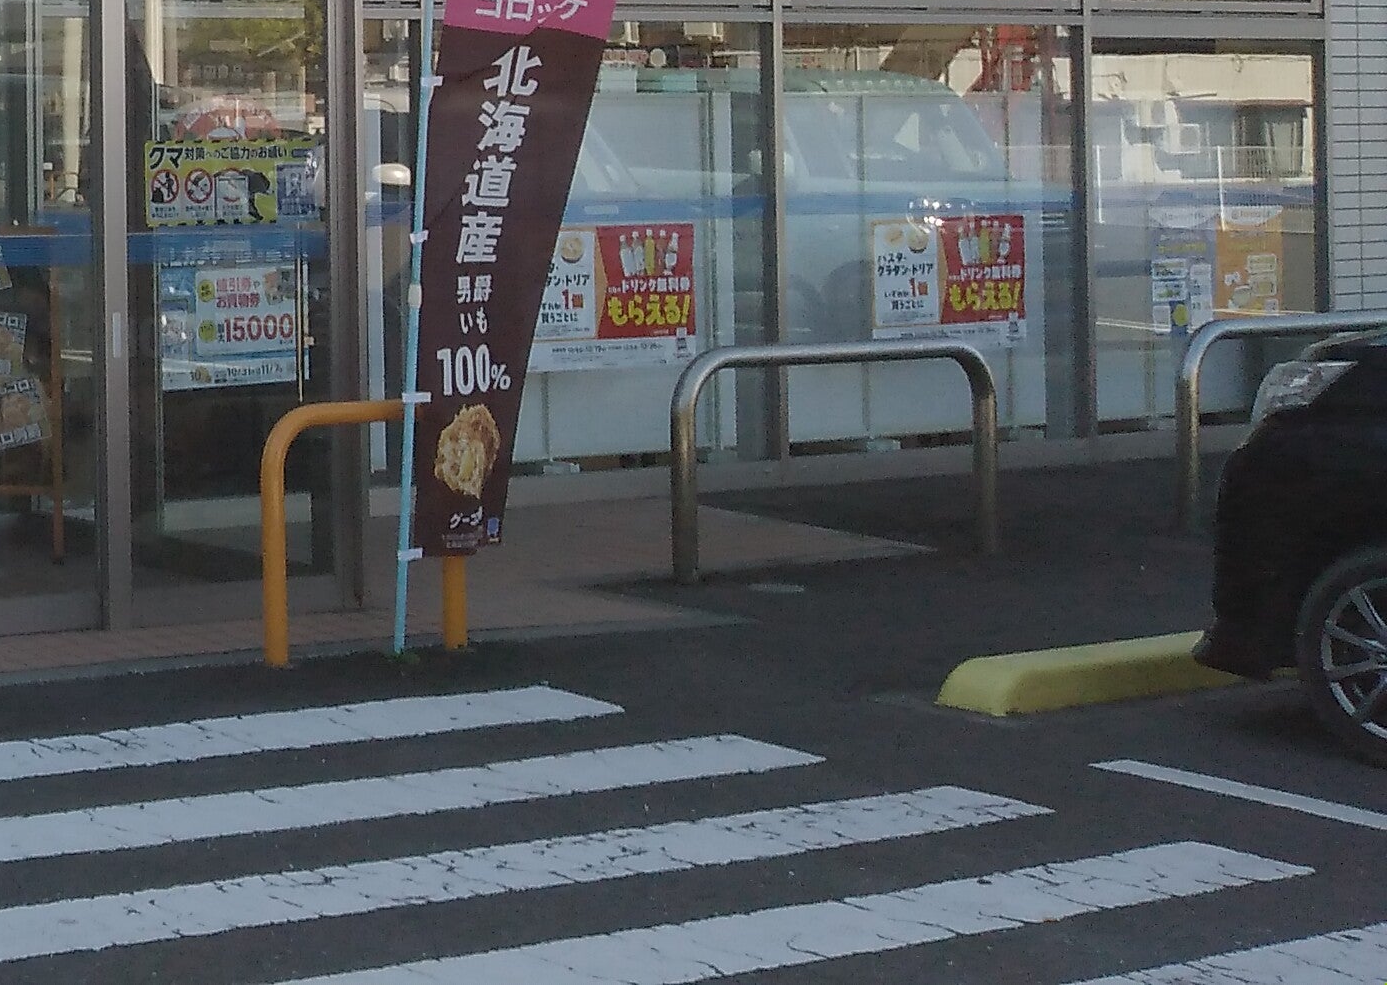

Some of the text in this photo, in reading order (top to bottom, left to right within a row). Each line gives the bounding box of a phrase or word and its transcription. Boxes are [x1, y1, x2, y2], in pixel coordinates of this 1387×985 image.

[456, 45, 542, 264] 北海道産
[457, 274, 493, 304] 男爵
[950, 282, 1021, 312] もらえる!
[460, 306, 488, 334] いも
[607, 293, 691, 327] もらえる!
[437, 343, 511, 396] 100%
